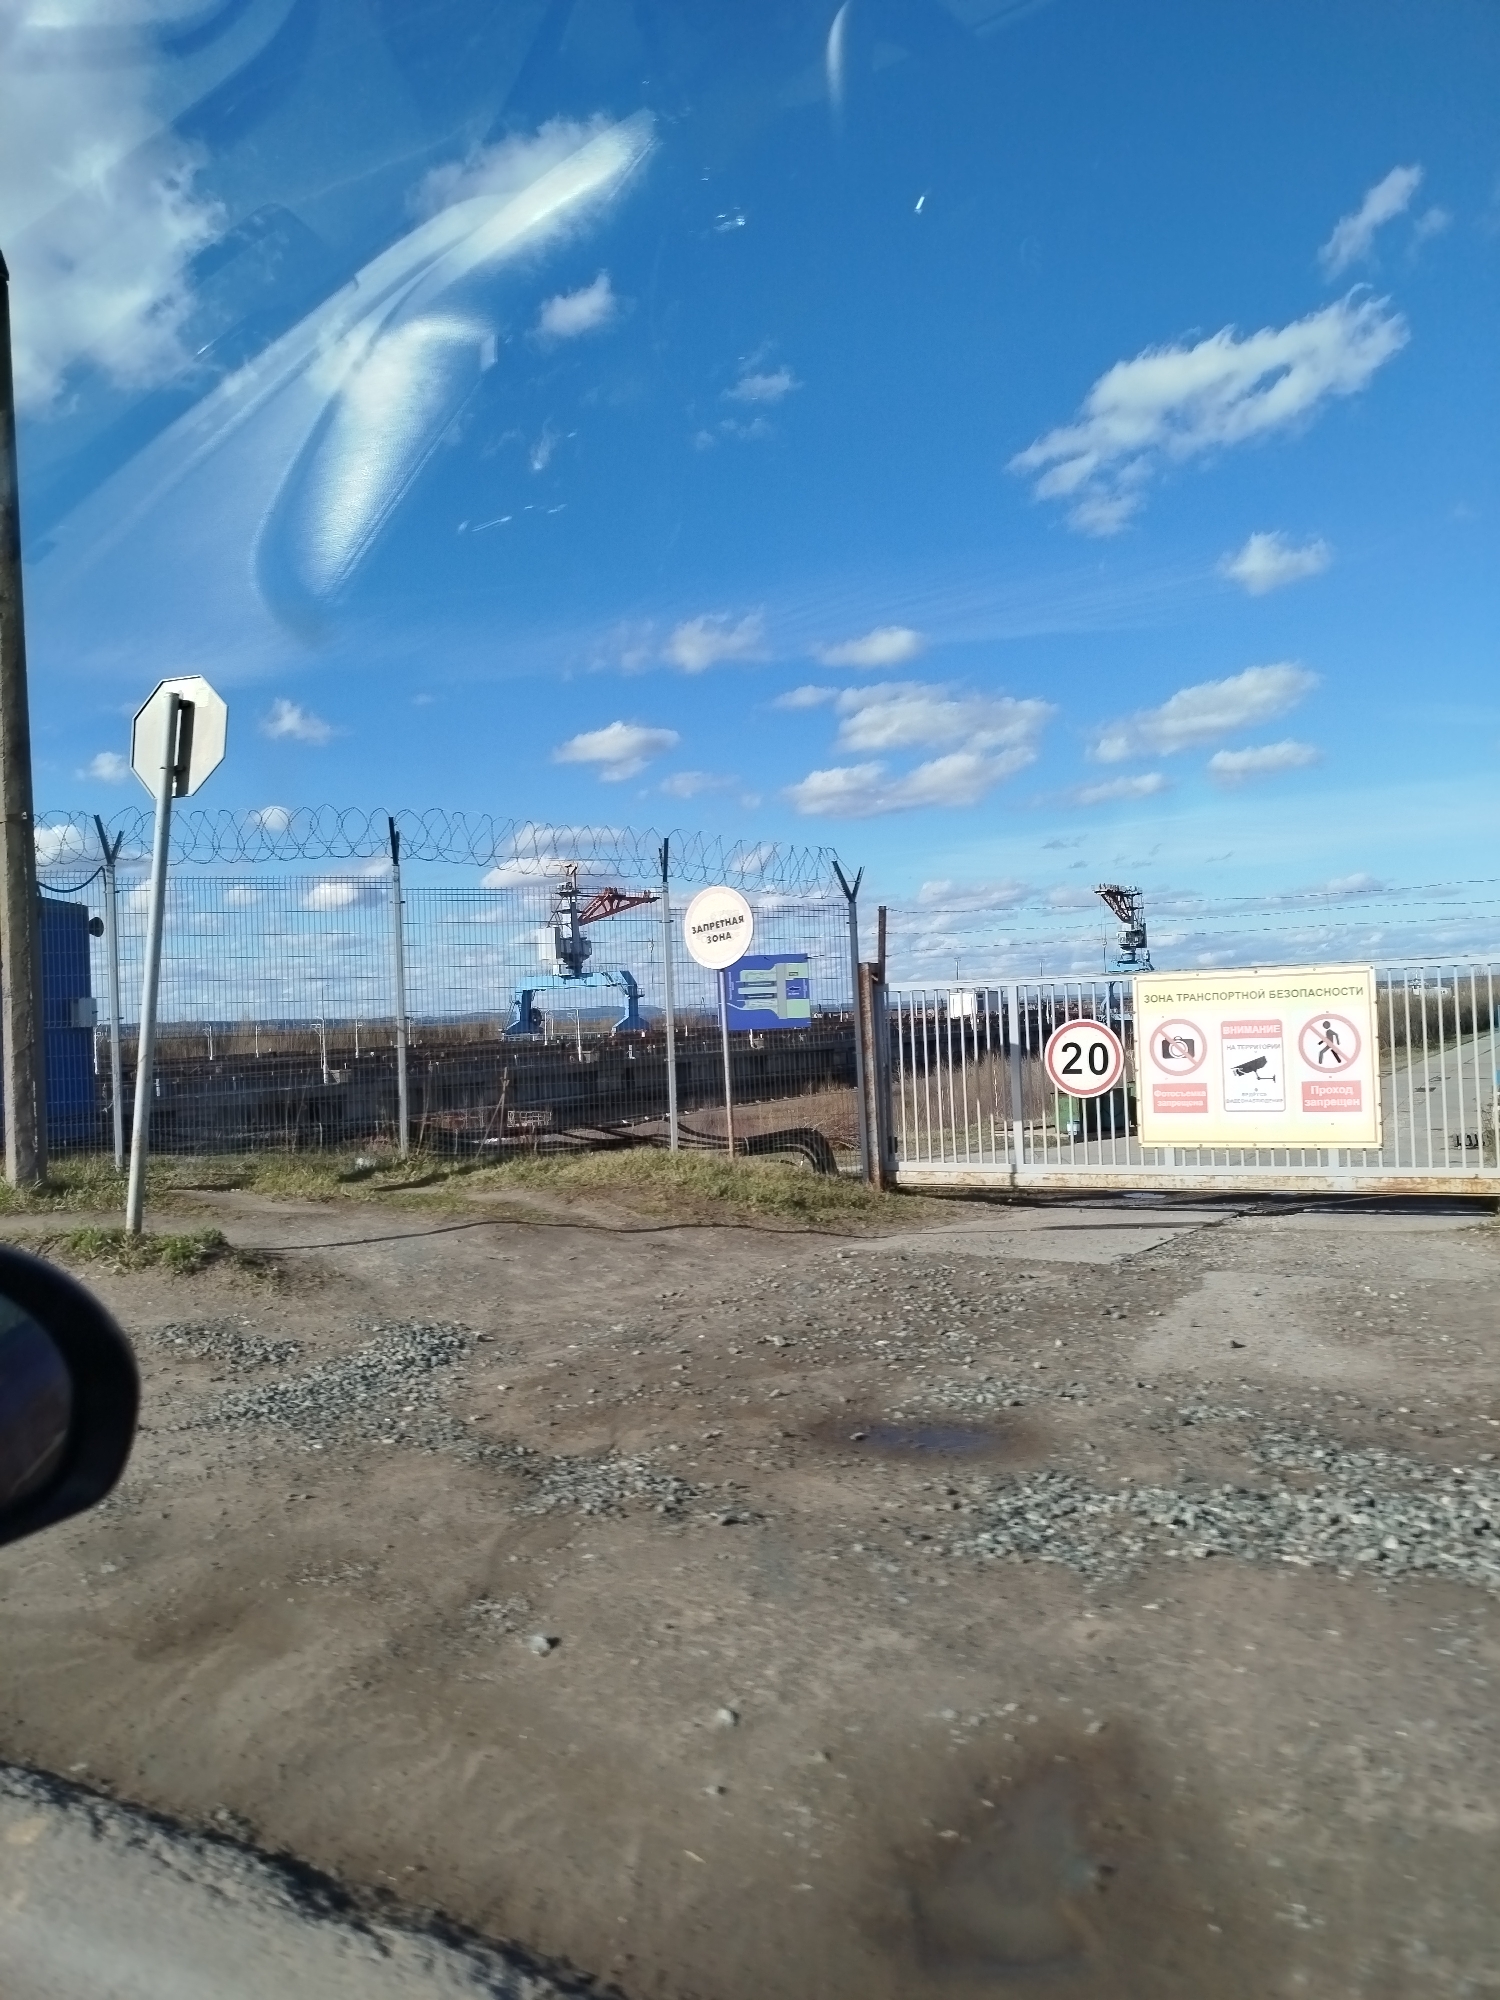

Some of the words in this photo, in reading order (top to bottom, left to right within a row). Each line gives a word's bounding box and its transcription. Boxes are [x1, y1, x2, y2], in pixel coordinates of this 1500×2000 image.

[691, 915, 744, 935] ЗАПРЕТНАЯ
[706, 931, 732, 944] ЗОНА
[1143, 993, 1174, 1004] ЗОНА
[1176, 989, 1266, 1003] ТРАНСПОРТНОЙ
[1269, 986, 1364, 999] БЕЗОПАСНОСТИ
[1222, 1024, 1281, 1035] ВНИМАНИЕ
[1061, 1042, 1110, 1076] 20
[1310, 1085, 1354, 1097] Проход
[1156, 1100, 1204, 1108] запрещена
[1304, 1098, 1361, 1109] запрещен
